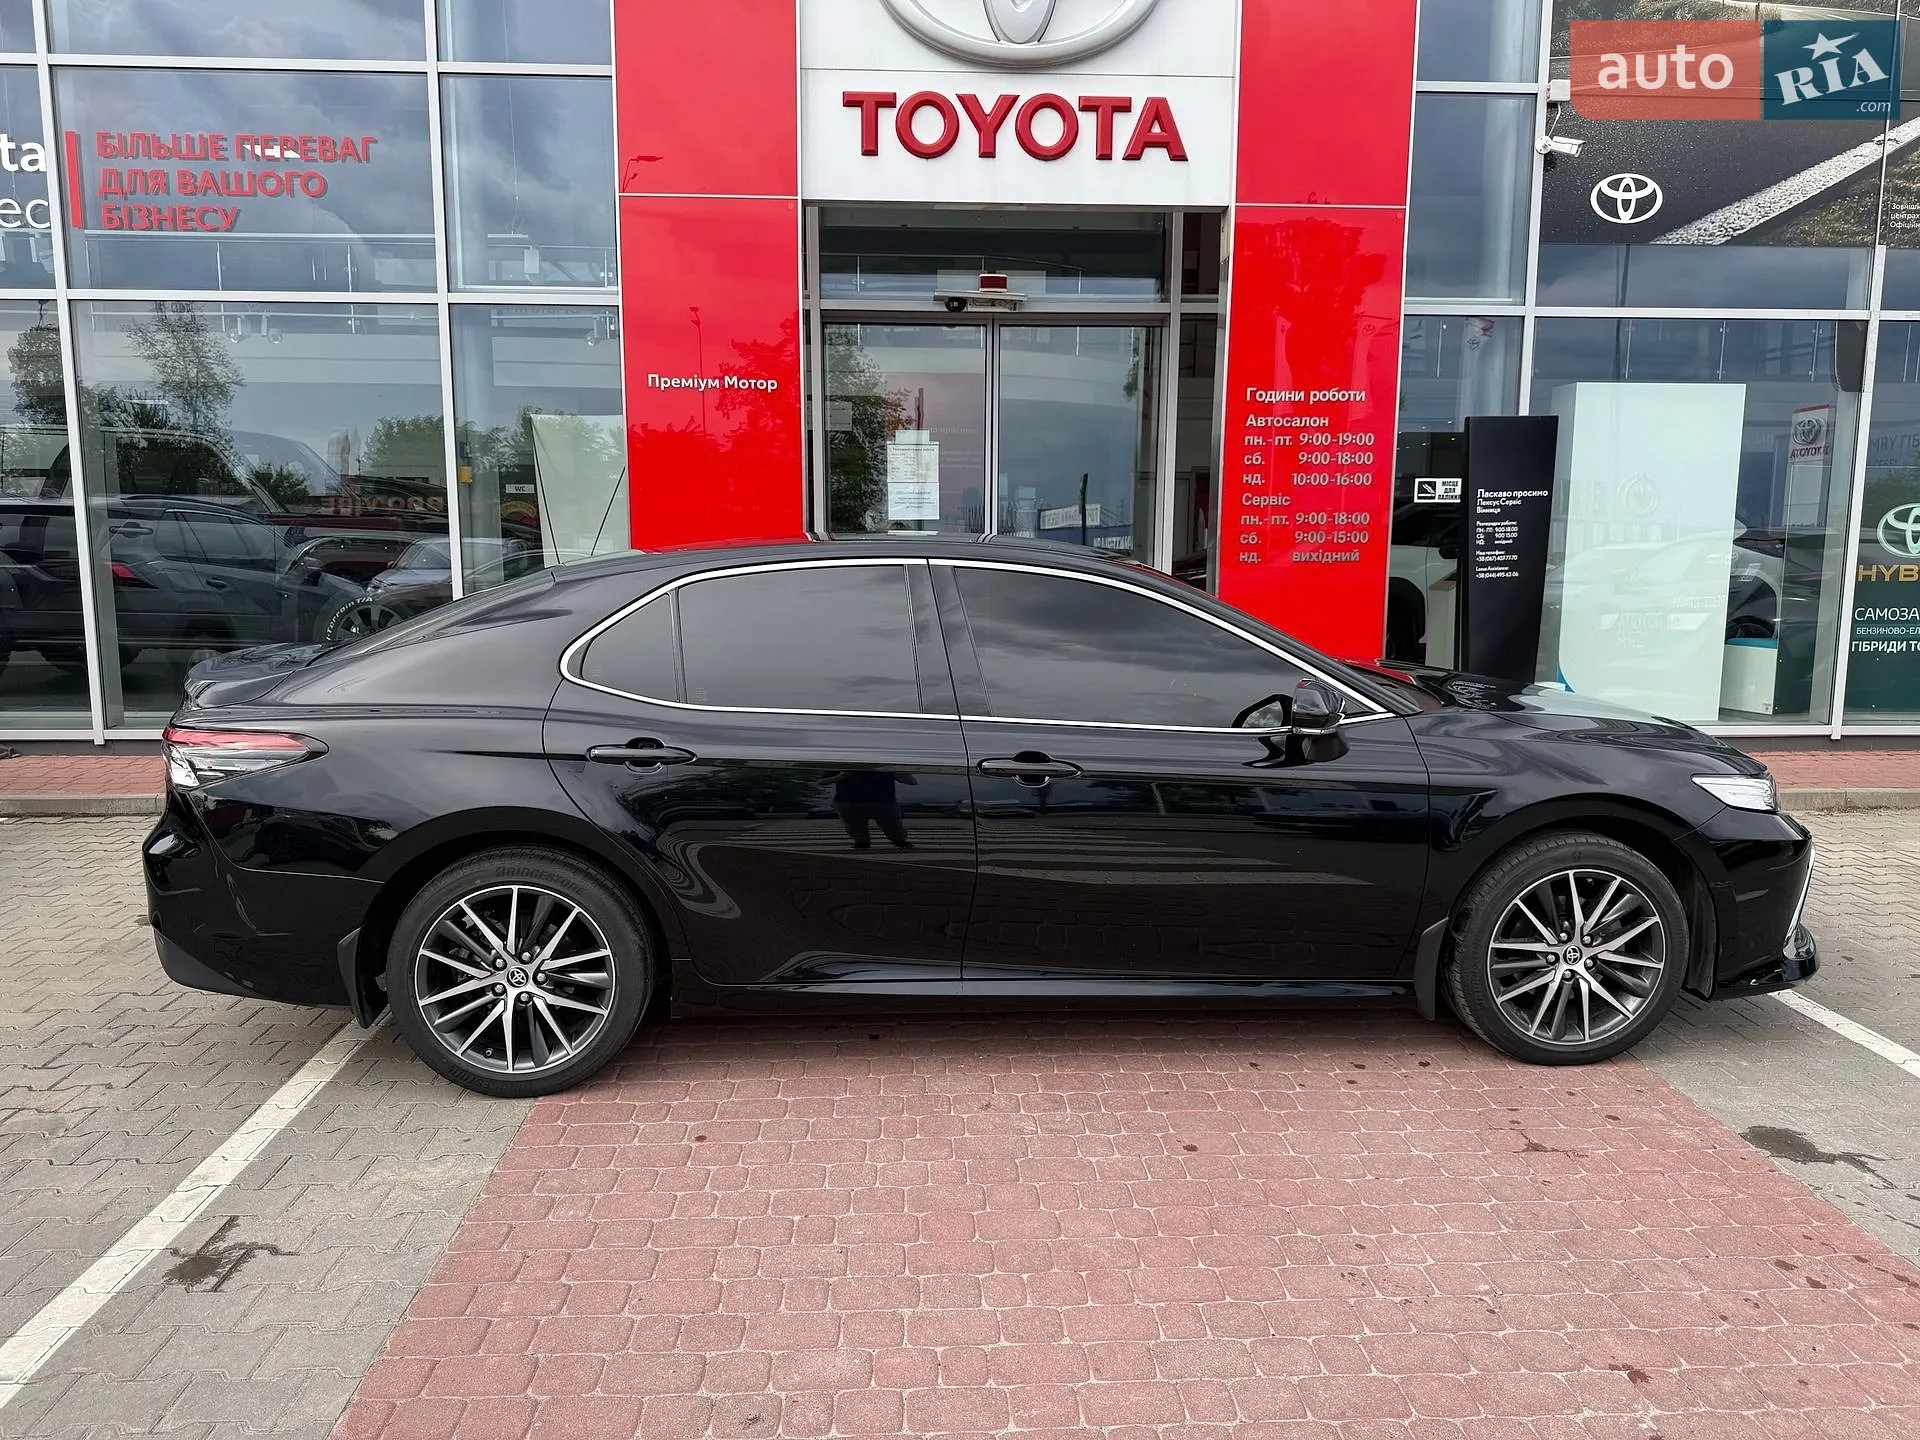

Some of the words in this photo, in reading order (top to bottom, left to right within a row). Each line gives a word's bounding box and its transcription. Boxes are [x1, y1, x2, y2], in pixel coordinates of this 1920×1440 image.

[842, 90, 1189, 162] TOYOTA
[95, 131, 228, 160] БІЛЬШЕ
[234, 133, 378, 163] ПЕРЕВАГ
[97, 167, 168, 199] ДЛЯ
[176, 169, 328, 198] ВАШОГО
[102, 202, 240, 231] БІЗНЕСУ
[647, 373, 720, 391] Преміум
[724, 375, 778, 393] Мотор
[1246, 387, 1305, 404] Години
[1309, 386, 1366, 405] роботи
[1245, 413, 1329, 427] Автосалон
[1299, 432, 1375, 446] 9:00-19:00
[1243, 452, 1265, 465] сб.
[1298, 451, 1374, 465] 9:00-18:00
[1242, 473, 1265, 486] нд.
[1291, 472, 1373, 486] 10:00-16:00
[1241, 492, 1291, 508] Сервіс
[1477, 488, 1512, 498] Ласкаво
[1513, 490, 1548, 499] просимо
[1295, 512, 1370, 525] 9:00-18:00
[1240, 532, 1262, 544] сб.
[1294, 530, 1369, 544] 9:00-15:00
[1239, 552, 1262, 563] нд.
[1292, 549, 1360, 563] вихідний
[1857, 564, 1920, 582] HYB
[1854, 607, 1920, 621] САМОЗА
[1851, 640, 1908, 654] ГІБРИДИ
